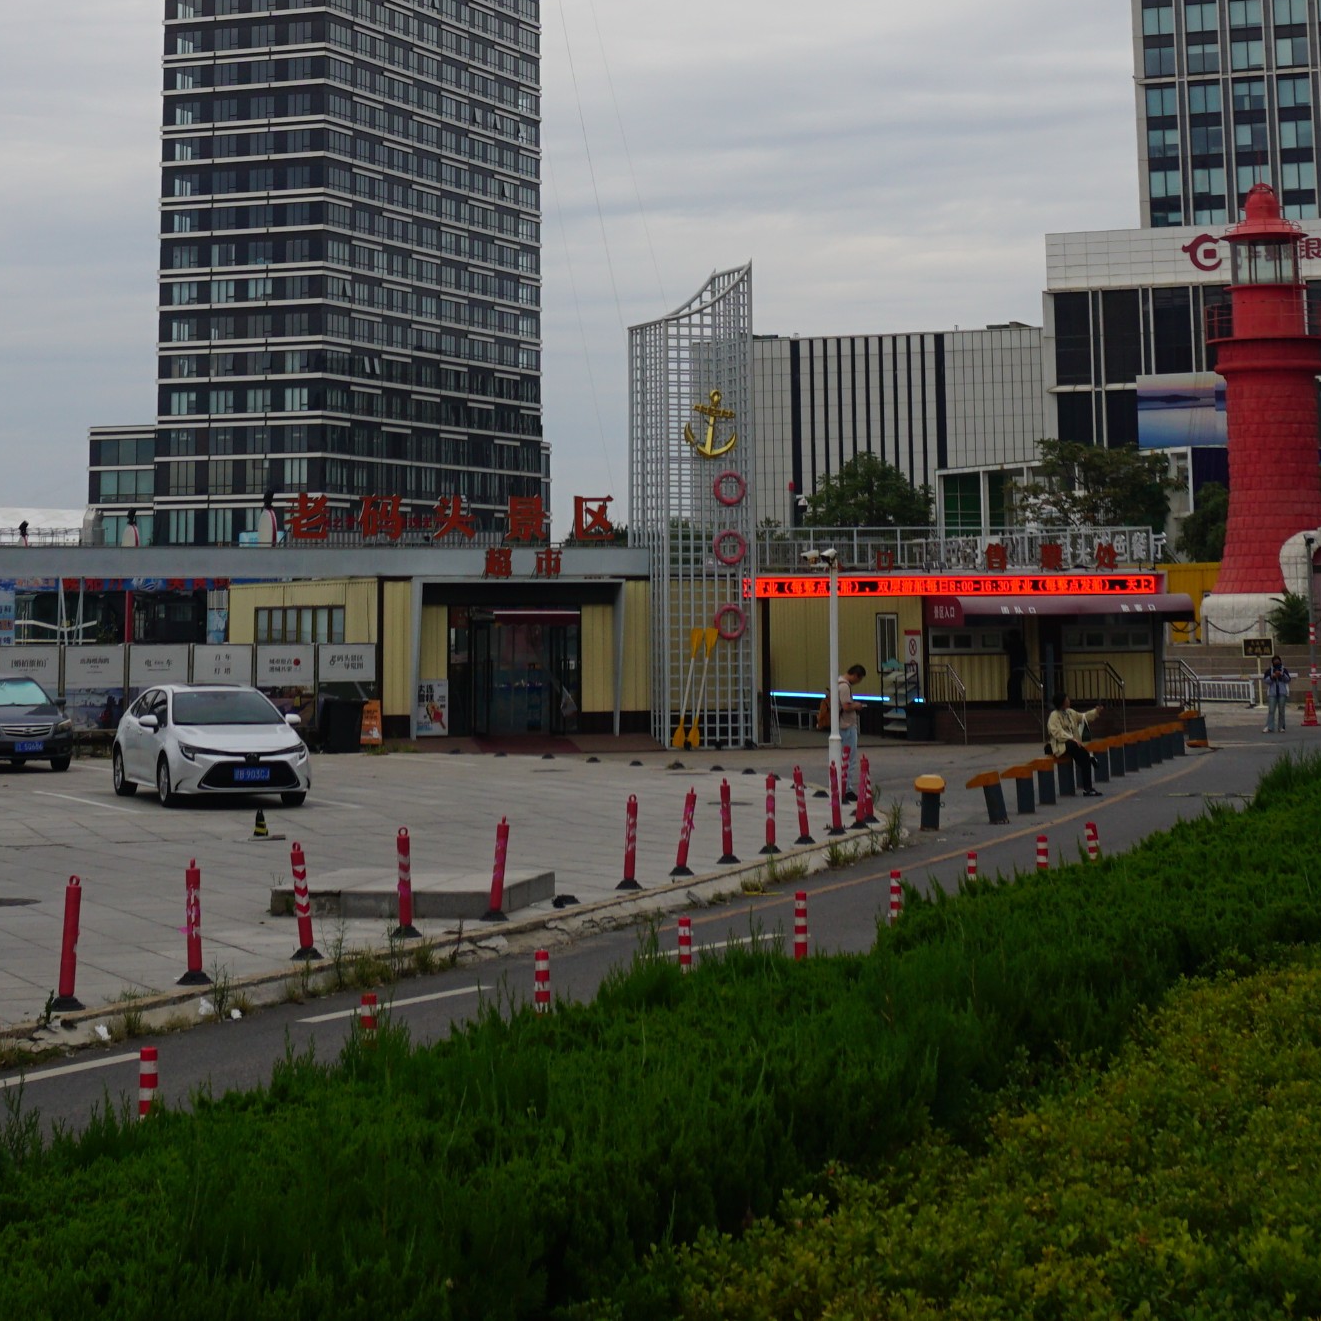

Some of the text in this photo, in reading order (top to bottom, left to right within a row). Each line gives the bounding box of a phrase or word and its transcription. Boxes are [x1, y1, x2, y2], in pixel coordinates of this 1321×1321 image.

[285, 492, 615, 541] 老码头景区
[485, 547, 563, 578] 超市
